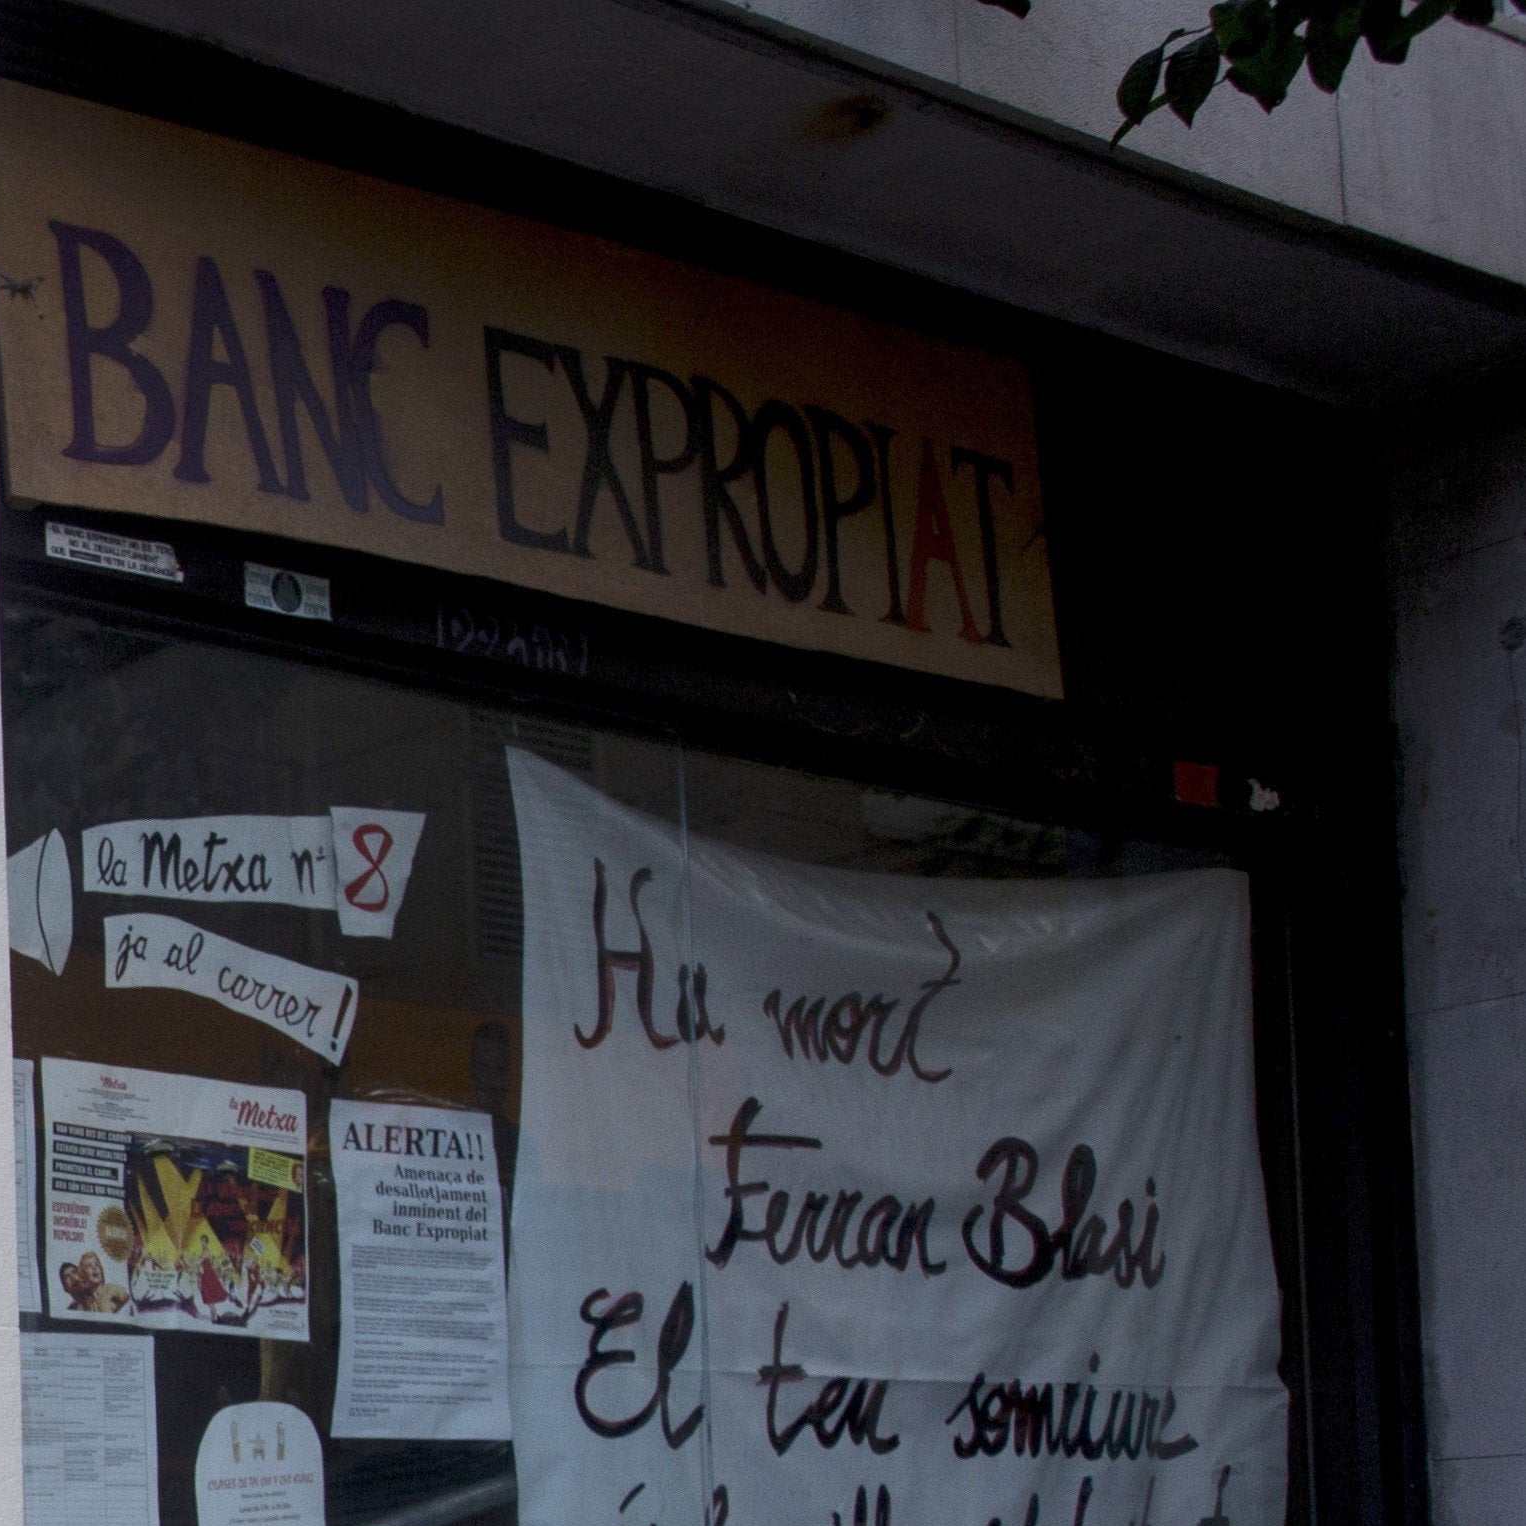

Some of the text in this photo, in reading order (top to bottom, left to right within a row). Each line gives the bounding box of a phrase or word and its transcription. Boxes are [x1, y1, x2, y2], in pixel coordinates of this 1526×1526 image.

[47, 221, 1015, 648] BANC EXPROPIAT
[97, 837, 127, 886] la
[140, 831, 272, 893] Metxa
[344, 823, 394, 913] 8
[115, 924, 148, 981] ja
[163, 921, 203, 974] al
[762, 909, 962, 1083] mort
[236, 1099, 299, 1132] Metxa
[342, 1120, 485, 1162] ALERTA!!
[375, 1180, 488, 1204] desallotjament
[394, 1163, 485, 1187] Amenaça de
[705, 1096, 1167, 1290] Ferran Blasi
[372, 1219, 489, 1244] Banc Expropiat
[393, 1201, 488, 1223] inminent del
[575, 1280, 705, 1450] El
[756, 1300, 900, 1457] teu
